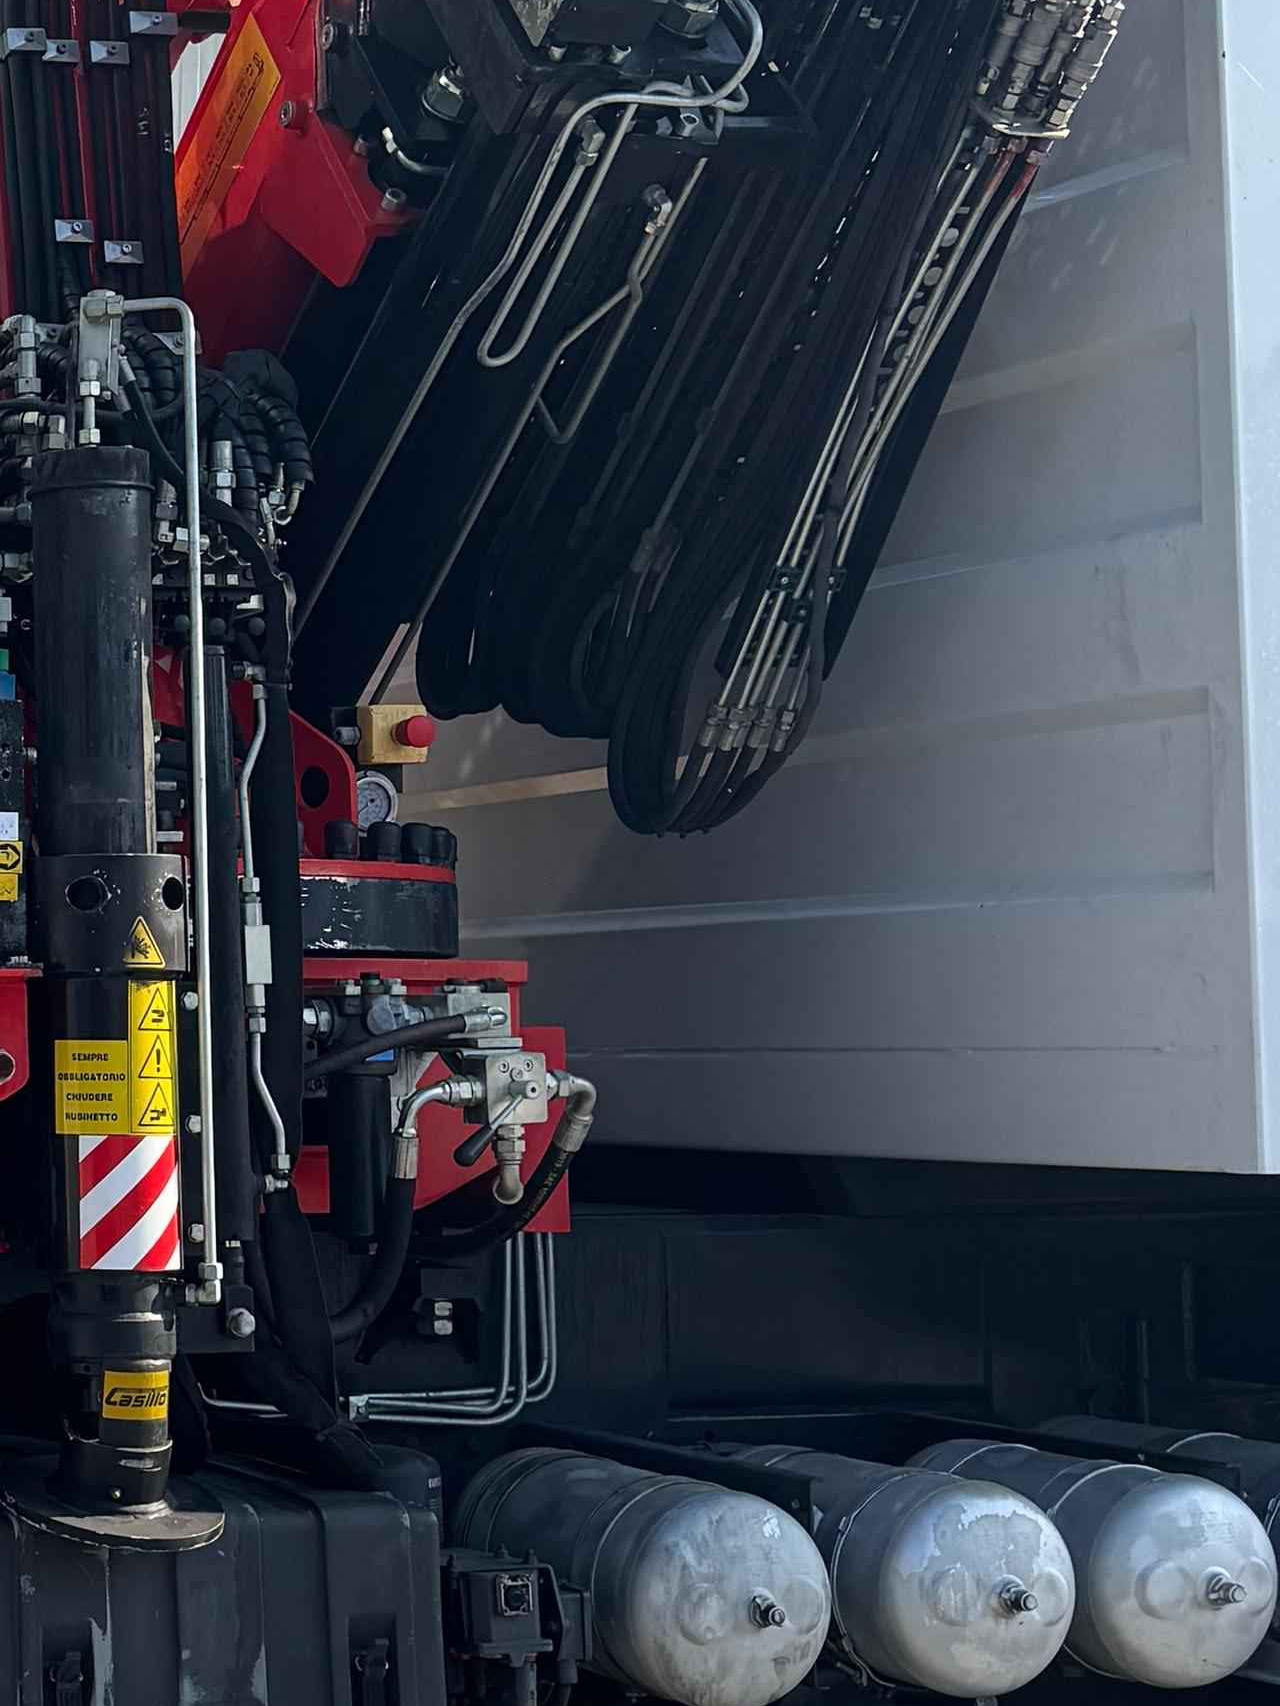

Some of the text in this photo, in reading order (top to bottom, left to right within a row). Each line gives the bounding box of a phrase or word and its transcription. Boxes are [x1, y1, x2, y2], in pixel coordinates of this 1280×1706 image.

[71, 1052, 109, 1062] SEMPRE
[57, 1072, 127, 1082] OBBLIGATORIO
[65, 1092, 114, 1102] CHIUDERE
[65, 1112, 119, 1122] RUBINETTO
